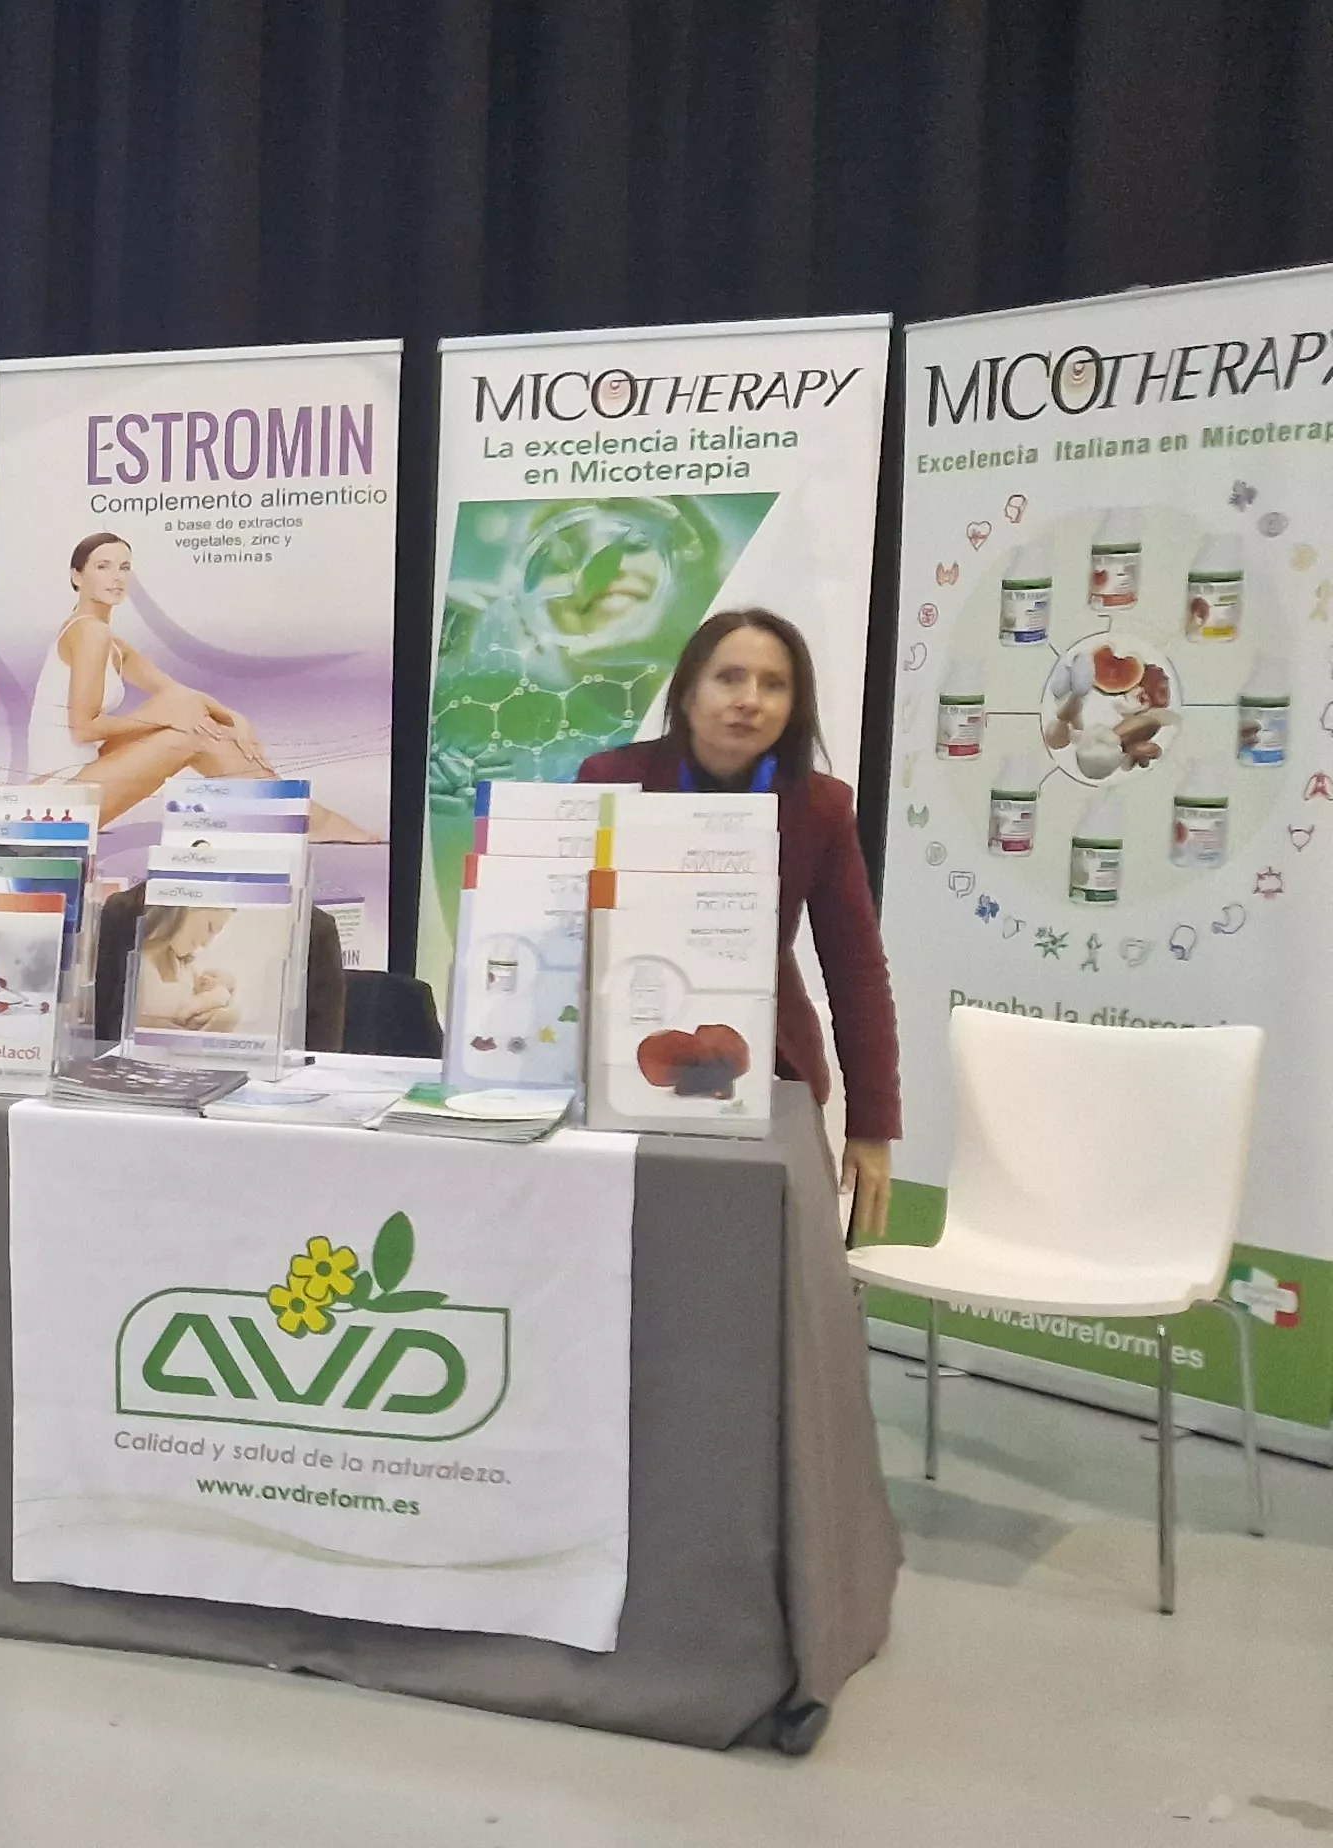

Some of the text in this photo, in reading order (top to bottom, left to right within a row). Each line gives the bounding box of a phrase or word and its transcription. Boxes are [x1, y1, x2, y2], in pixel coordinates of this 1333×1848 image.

[472, 367, 864, 424] MICOTHERAPY
[924, 331, 1333, 428] MICOTHERAP
[87, 403, 374, 486] ESTROMIN
[484, 425, 799, 459] La excelencia italiana
[918, 445, 1039, 475] Excelencia
[1056, 436, 1151, 463] Italiana
[1160, 432, 1188, 453] en
[524, 456, 751, 486] en Micoterapia
[91, 485, 388, 516] Complemento alimenticio
[164, 515, 304, 532] a base de extractos
[175, 532, 293, 550] vegetales, zinc y
[193, 549, 273, 565] vitaminas
[949, 1301, 1205, 1369] www.avdreformes
[141, 1312, 467, 1416] AVD
[114, 1431, 512, 1486] Calidad y salud de la naturaleza.
[196, 1477, 421, 1516] www.avdreform.es
